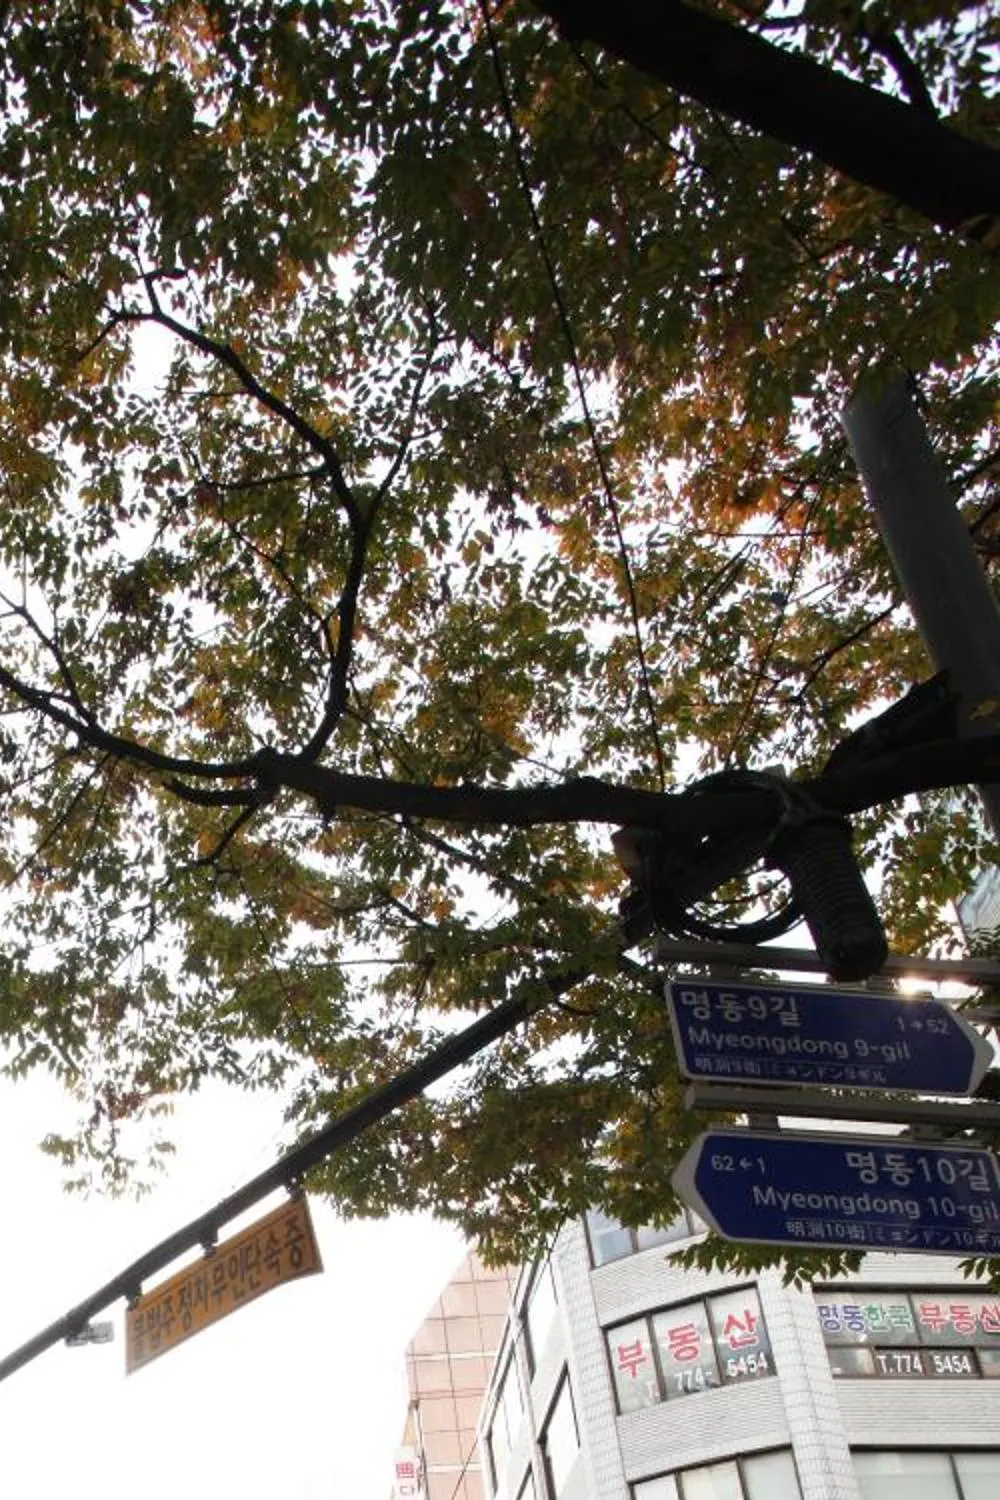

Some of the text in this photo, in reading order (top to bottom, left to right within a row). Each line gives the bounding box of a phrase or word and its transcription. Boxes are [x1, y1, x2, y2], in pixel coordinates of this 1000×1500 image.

[681, 990, 801, 1027] 명동9길
[687, 1026, 911, 1063] Myeongdong 9-gil
[711, 1154, 734, 1172] 62
[845, 1151, 991, 1193] 명동10길
[752, 1185, 1000, 1223] Myeongdong 10-gil
[918, 1302, 1000, 1334] 부동산
[615, 1308, 760, 1379] 부동산
[726, 1352, 769, 1378] 5454
[933, 1353, 973, 1374] 5454
